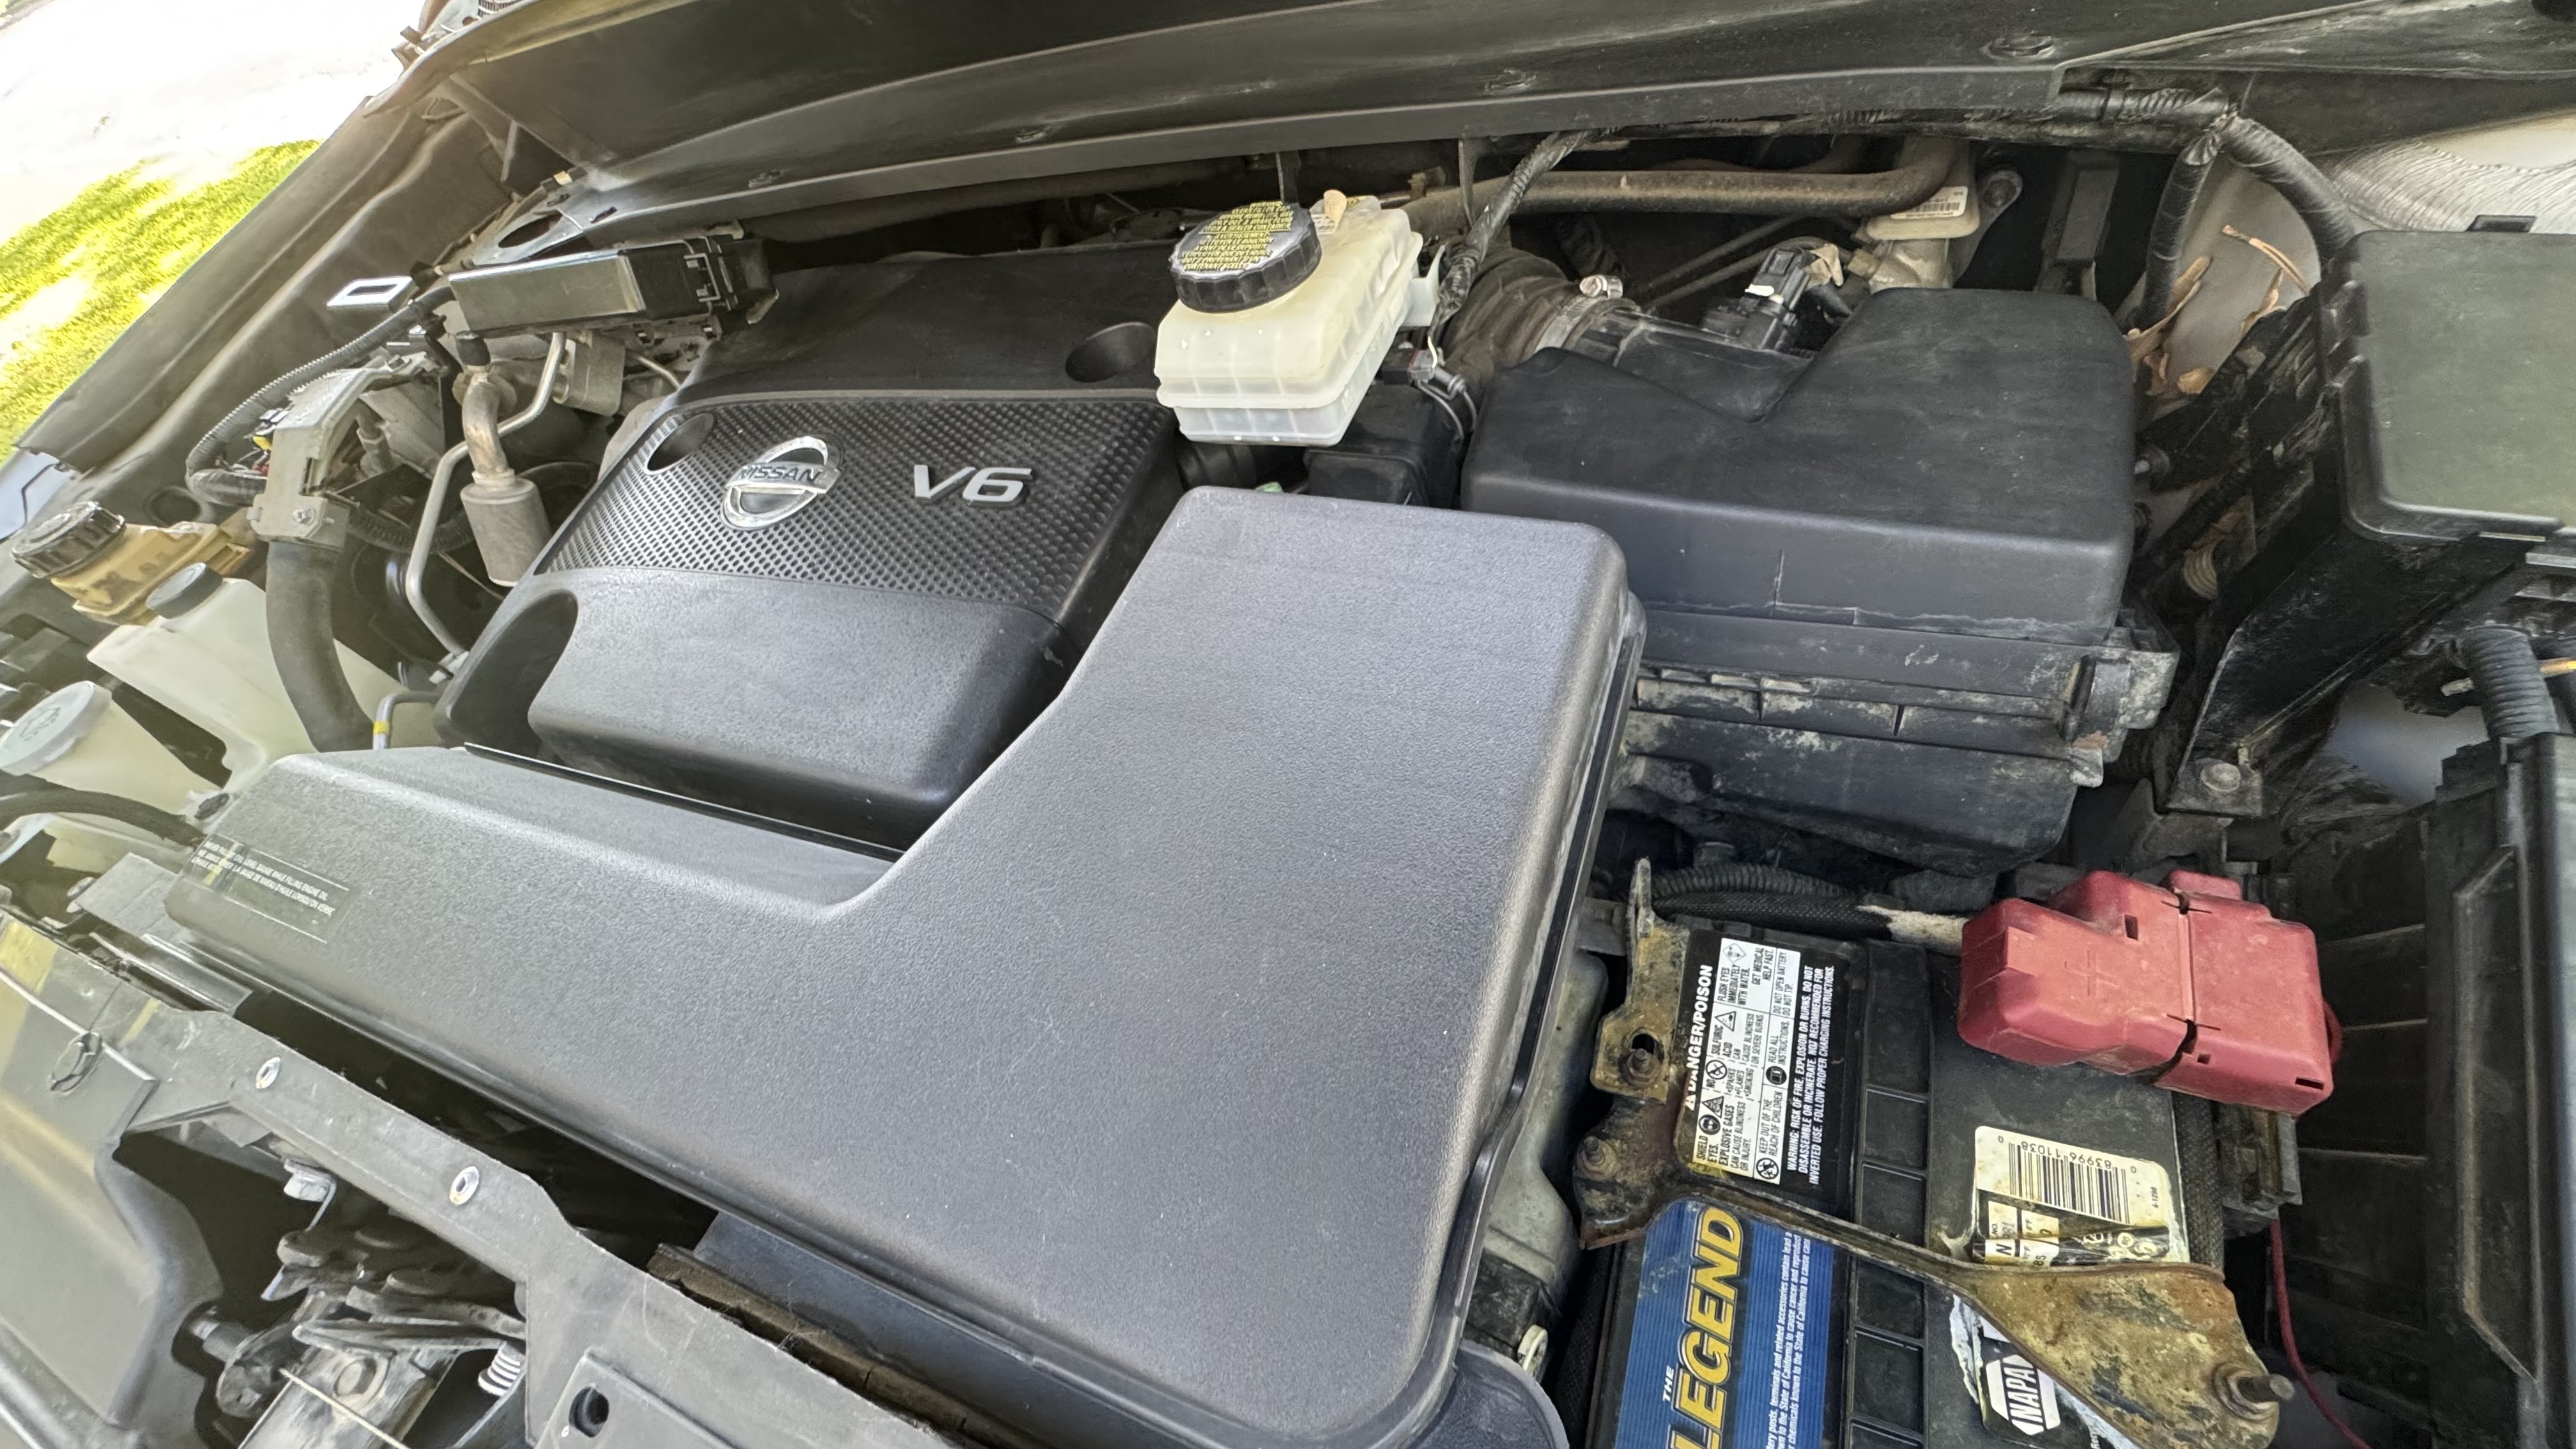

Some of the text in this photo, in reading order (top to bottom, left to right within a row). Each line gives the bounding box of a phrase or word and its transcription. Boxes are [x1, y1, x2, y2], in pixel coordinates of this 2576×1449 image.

[736, 466, 822, 482] NISSAN
[914, 464, 1033, 507] V6
[1751, 946, 1764, 985] GET MEDICAL
[1762, 965, 1772, 981] HELP
[1803, 965, 1813, 981] NOT
[1813, 967, 1823, 983] FOR
[1717, 966, 1729, 1002] FLUSH EYES
[1727, 963, 1740, 1004] IMMEDIATELY
[1775, 976, 1784, 992] OPEN
[1802, 980, 1812, 992] DO
[1737, 990, 1747, 1006] WITH
[1774, 992, 1782, 1004] NOT
[1782, 994, 1792, 1006] NOT
[1799, 992, 1811, 1020] BURNS.
[1772, 1004, 1781, 1014] DO
[1782, 1006, 1791, 1016] DO
[1809, 983, 1822, 1039] RECOMMENDED
[1798, 1020, 1809, 1032] OR
[1711, 1024, 1723, 1055] SULFURIC
[1742, 1013, 1754, 1062] CAUSE BLINDNESS
[1752, 1034, 1761, 1055] SEVERE
[1807, 1039, 1818, 1055] NOT
[1722, 1041, 1733, 1057] ACID
[1733, 1047, 1741, 1060] CAN
[1768, 1034, 1779, 1063] READ ALL
[1795, 1032, 1807, 1075] EXPLOSION
[1751, 1055, 1759, 1064] OR
[1705, 1078, 1715, 1089] NO
[1809, 964, 1834, 1184] INVERTED USE. FOLLOW PROPER CHARGING INSTRUCTIONS.
[1792, 1096, 1802, 1108] OF
[1802, 1103, 1813, 1116] OR
[1758, 1098, 1772, 1154] KEEP OUT OF THE
[1770, 1123, 1780, 1133] OF
[1790, 1108, 1801, 1129] RISK
[1718, 1103, 1735, 1166] EXPLOSIVE GASES
[1730, 1100, 1745, 1169] CAN CAUSE BLINDNESS
[1768, 1133, 1779, 1157] REACH
[1797, 1116, 1812, 1174] DISASSEMBLE
[1696, 1135, 1708, 1160] SHIELD
[1707, 1141, 1719, 1163] EYES.
[1740, 1136, 1751, 1171] OR INJURY.
[1786, 1129, 1800, 1172] WARNING:
[2021, 1141, 2061, 1158] 11038
[2069, 1152, 2112, 1170] 83996
[2131, 1165, 2136, 1174] 0
[1782, 1237, 1791, 1254] lead
[1780, 1254, 1790, 1280] contain
[1790, 1268, 1798, 1282] and
[1801, 1254, 1809, 1276] cause
[1799, 1276, 1807, 1284] to
[1776, 1280, 1788, 1324] accessories
[1788, 1283, 1798, 1308] cancer
[1796, 1284, 1807, 1321] California
[1661, 1205, 1744, 1449] LEGEND
[1786, 1309, 1795, 1332] cause
[1796, 1321, 1804, 1330] of
[1774, 1324, 1784, 1351] related
[1786, 1332, 1794, 1340] to
[1794, 1331, 1804, 1351] State
[1772, 1352, 1782, 1368] and
[1782, 1341, 1793, 1379] California
[1793, 1352, 1802, 1365] the
[1793, 1365, 1801, 1374] to
[1661, 1365, 1675, 1402] THE
[1769, 1368, 1781, 1406] terminals
[1781, 1380, 1790, 1389] of
[1790, 1375, 1800, 1402] known
[1779, 1390, 1790, 1411] State
[2004, 1367, 2043, 1423] NAPA
[1779, 1411, 1788, 1425] the
[1787, 1402, 1798, 1443] chemicals
[1778, 1426, 1786, 1435] to
